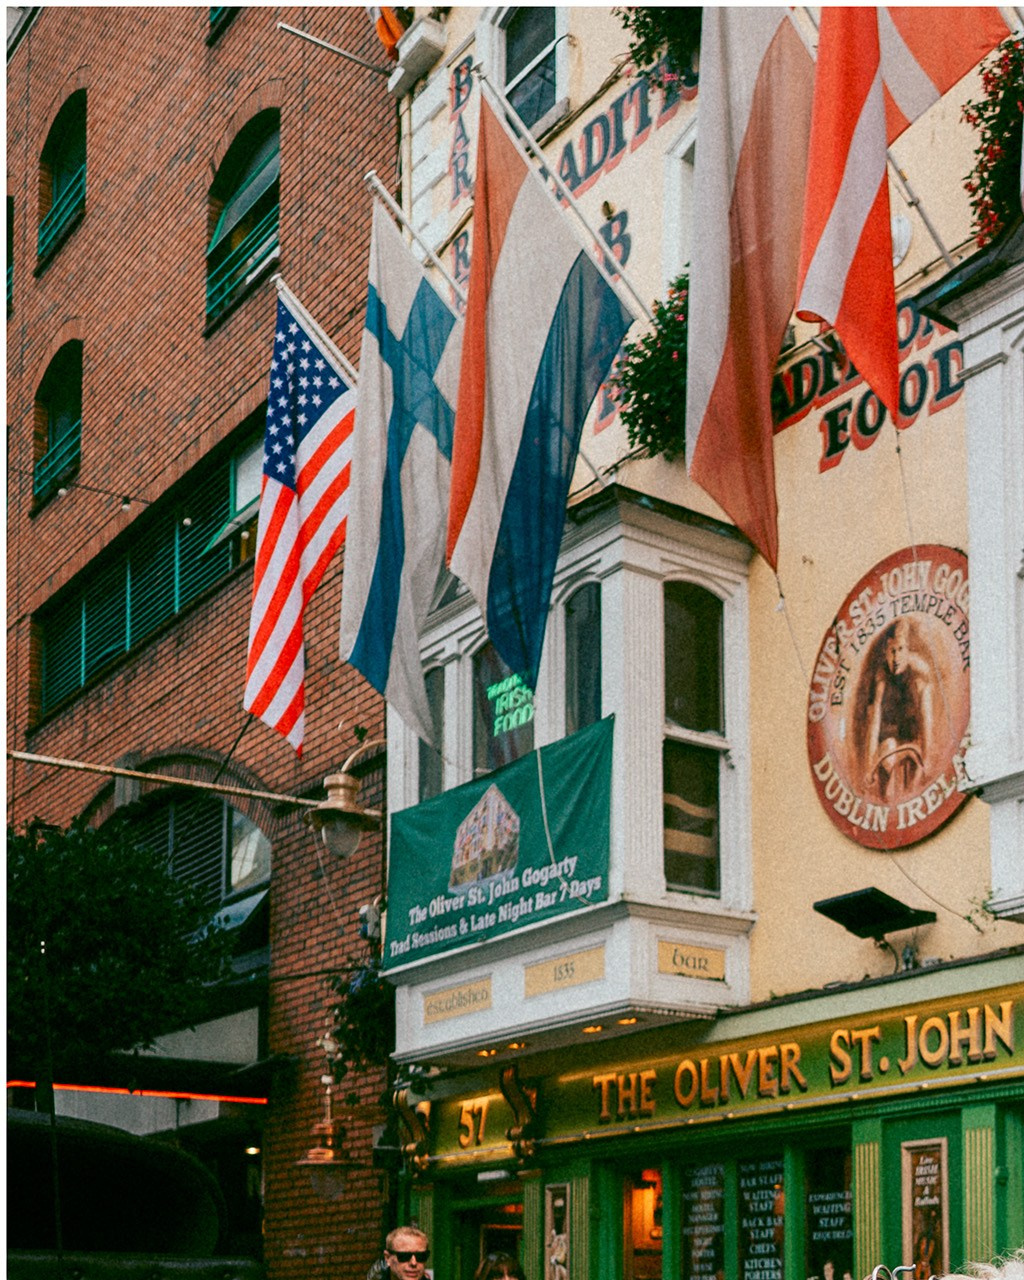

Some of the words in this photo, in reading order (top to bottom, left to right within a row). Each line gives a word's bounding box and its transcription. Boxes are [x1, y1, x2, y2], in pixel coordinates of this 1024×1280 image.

[878, 560, 932, 600] JOHN
[850, 607, 887, 654] 1835
[891, 593, 957, 627] TEMPLE
[813, 755, 890, 833] DUBLIN
[389, 933, 411, 958] Trad
[412, 922, 457, 950] Sessions
[459, 917, 469, 935] &
[470, 911, 496, 933] Late
[498, 899, 533, 925] Night
[535, 891, 557, 911] Bar
[560, 882, 567, 901] 7
[569, 875, 602, 899] Days
[409, 905, 427, 926] The
[429, 894, 465, 916] Oliver
[467, 886, 484, 906] St.
[487, 878, 520, 904] John
[522, 855, 578, 888] Gogarty
[593, 1069, 657, 1121] THE
[674, 1042, 807, 1108] OLIVER
[829, 1026, 890, 1086] ST.
[898, 1000, 1015, 1076] JOHN
[459, 1099, 490, 1149] 57
[819, 1216, 845, 1227] STAFF
[744, 1258, 782, 1269] KITCHEN
